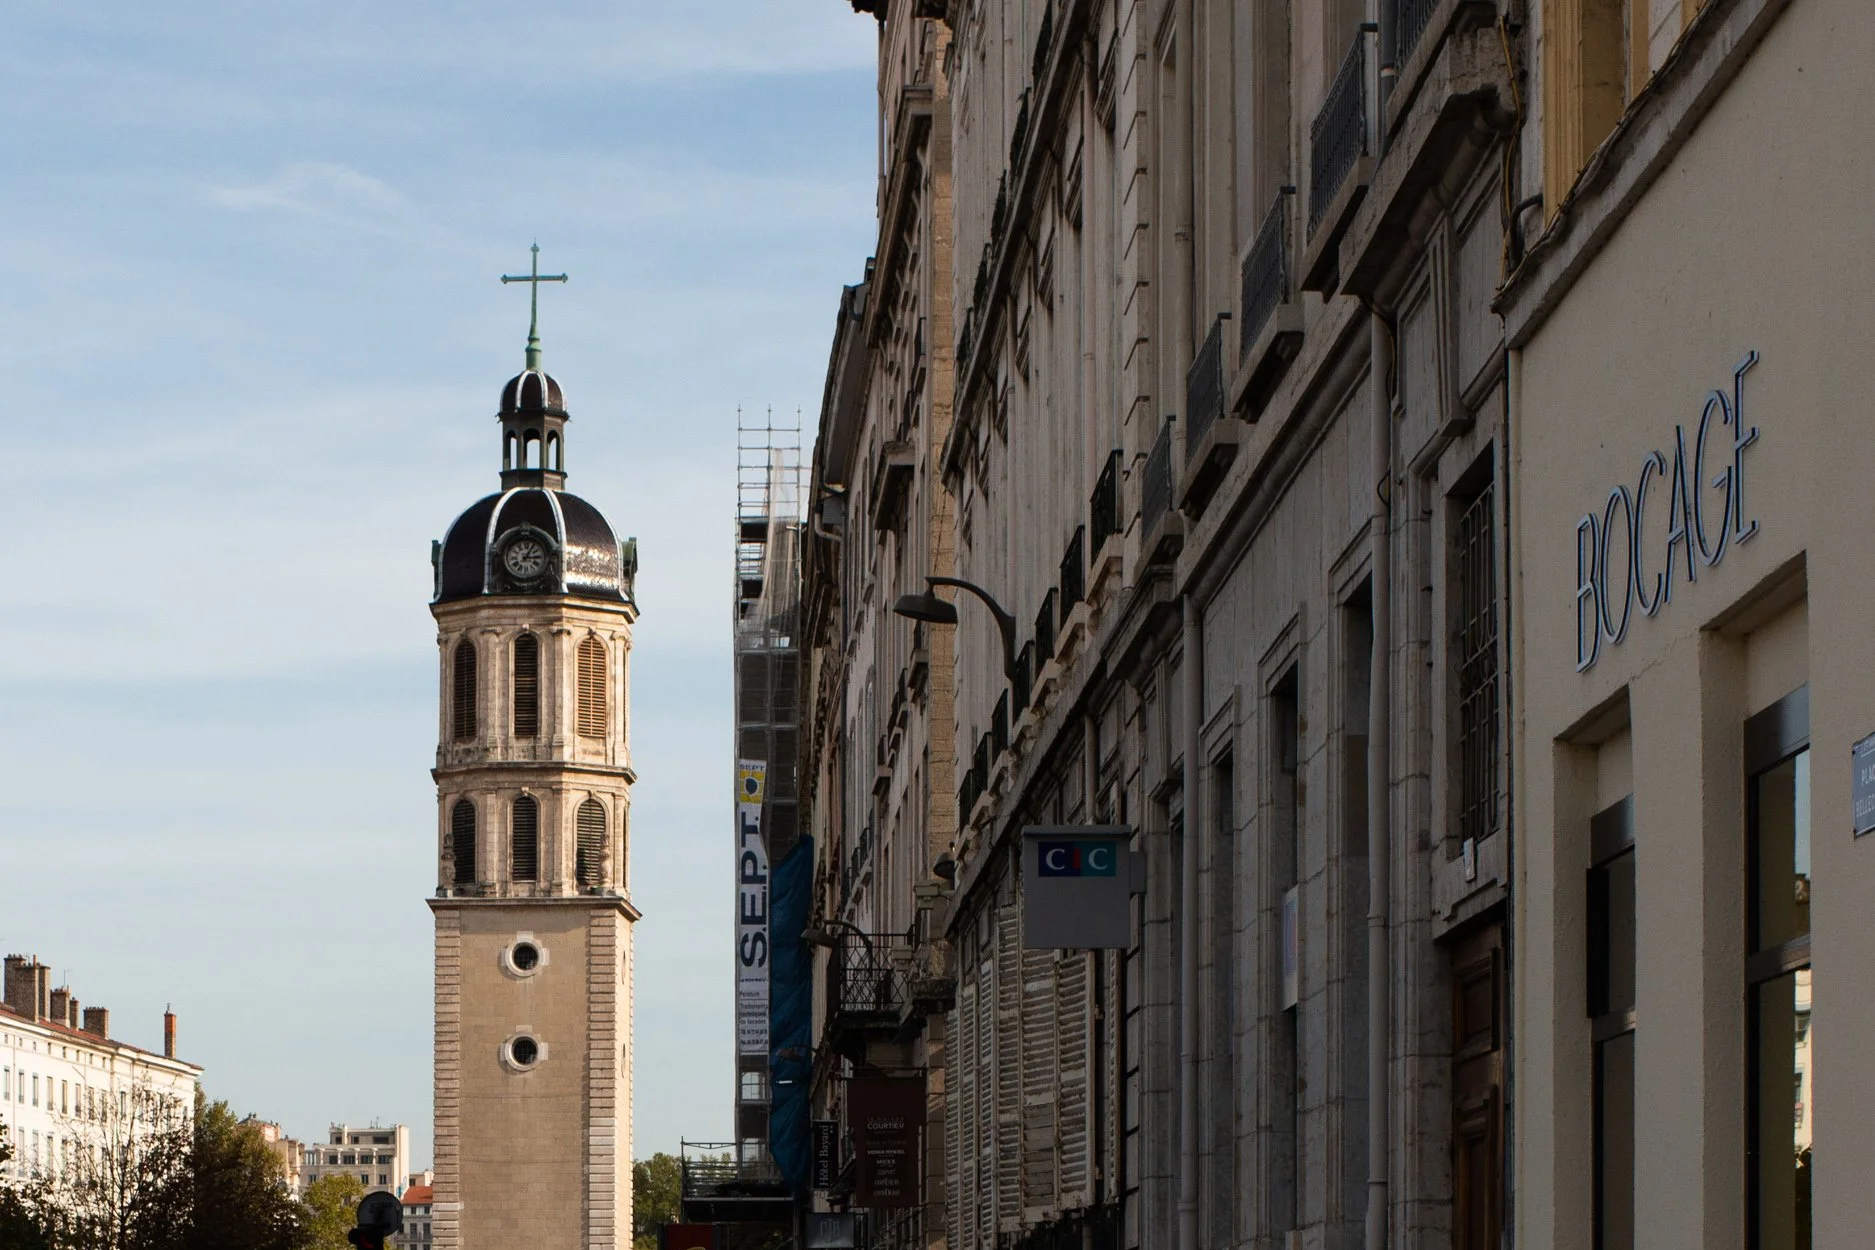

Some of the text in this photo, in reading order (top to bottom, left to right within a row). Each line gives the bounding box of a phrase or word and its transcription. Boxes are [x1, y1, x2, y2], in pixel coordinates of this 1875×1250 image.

[1575, 350, 1760, 675] BOCAGE
[1045, 847, 1109, 870] CIC
[819, 1125, 831, 1157] Bayard
